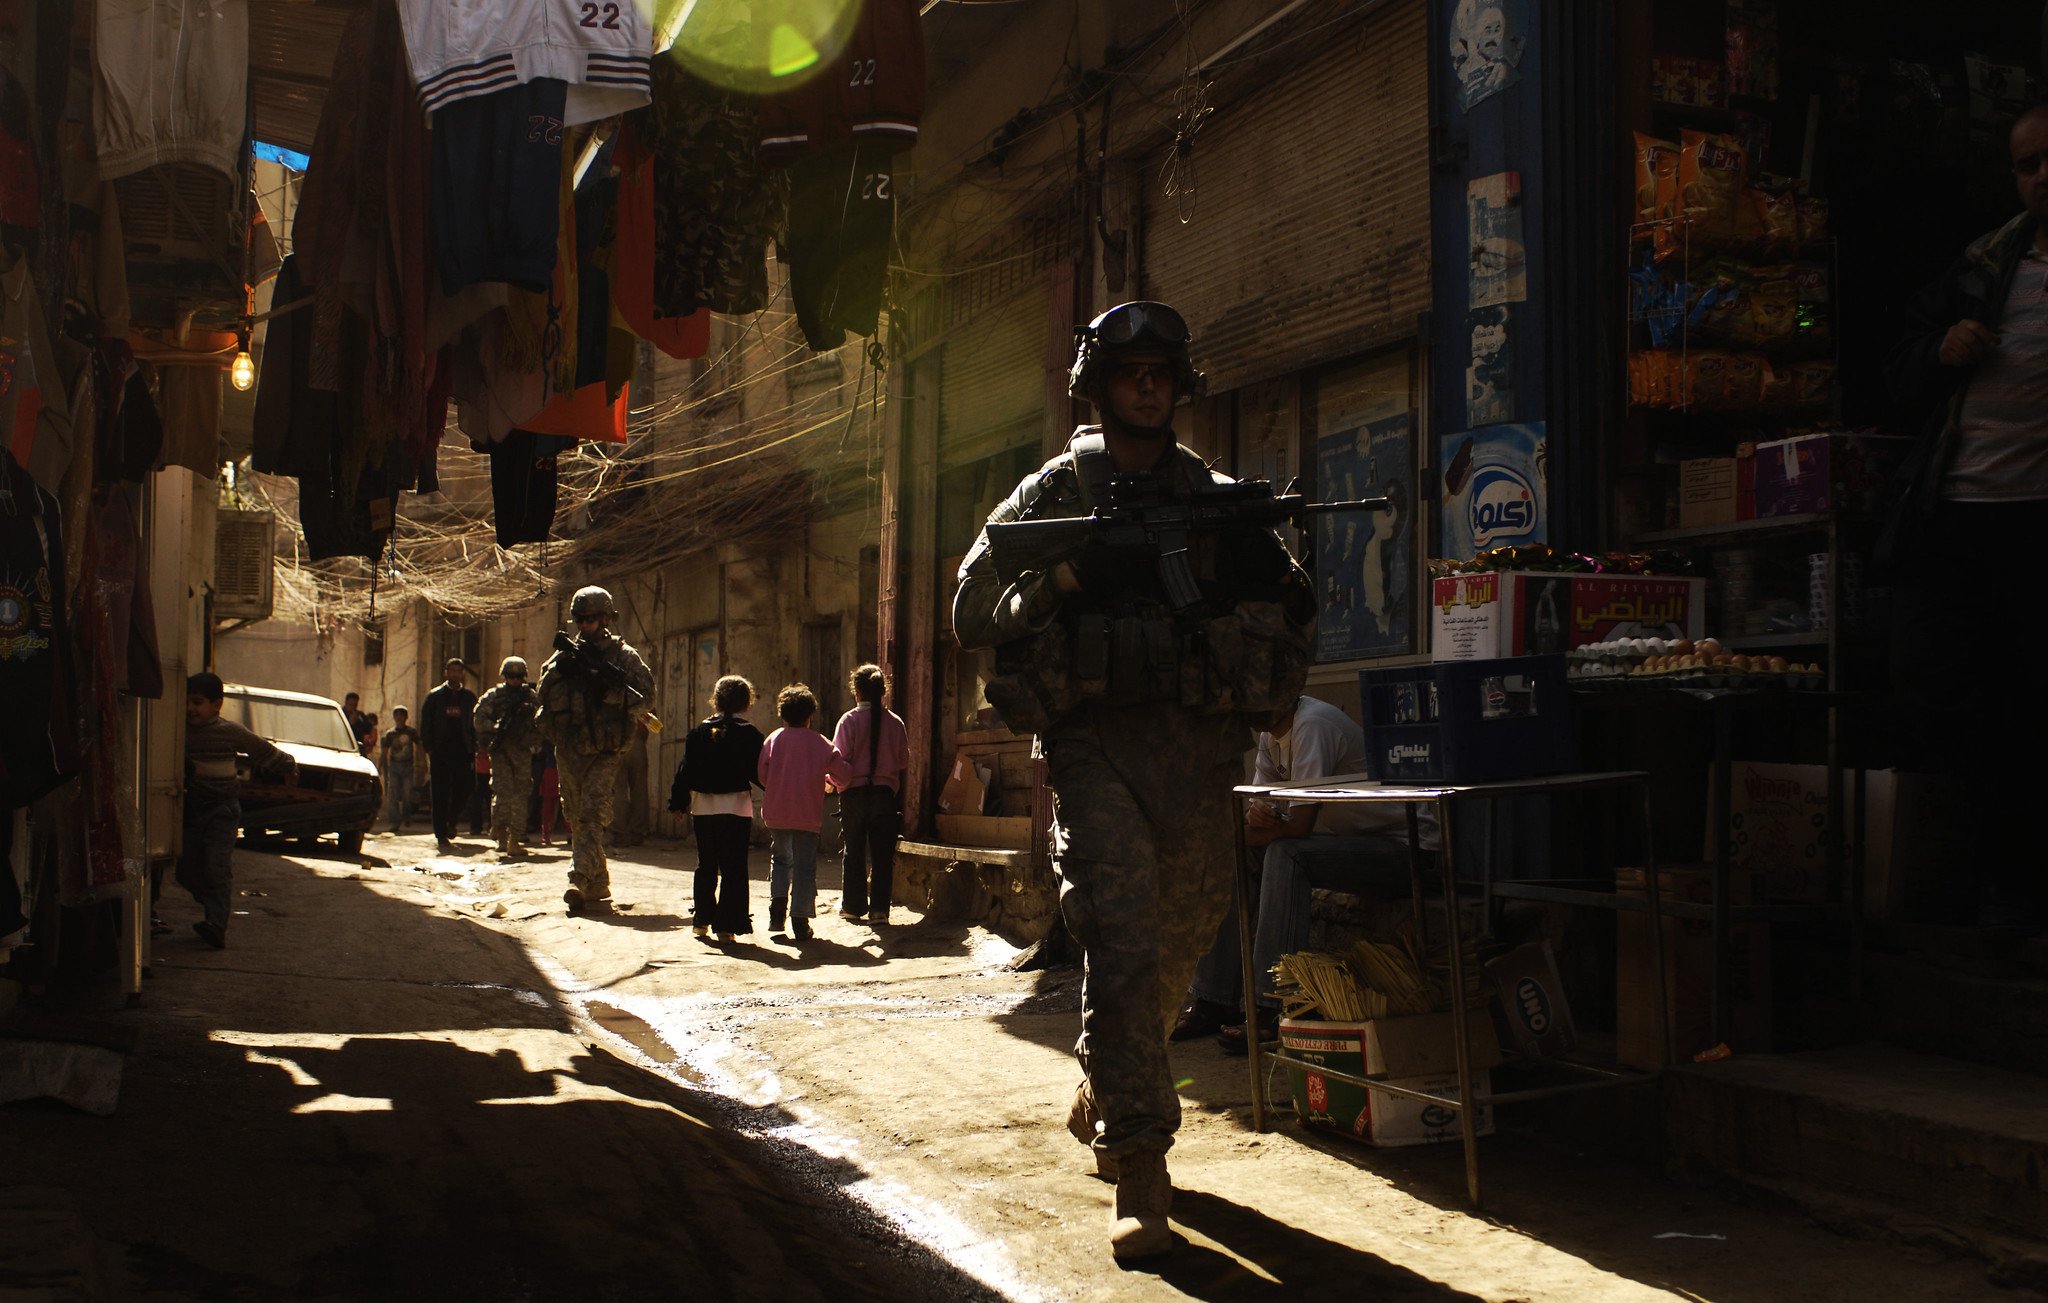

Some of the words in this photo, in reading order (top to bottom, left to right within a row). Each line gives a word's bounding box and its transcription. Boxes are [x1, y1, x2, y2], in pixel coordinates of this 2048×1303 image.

[580, 2, 620, 30] 22
[849, 58, 877, 87] 22
[527, 114, 564, 146] 22
[862, 173, 890, 200] 22
[1441, 581, 1492, 615] الرياي
[1576, 582, 1597, 593] AL
[1609, 582, 1687, 595] RIYADHI
[1575, 591, 1685, 632] الرياضي
[1744, 774, 1801, 801] Winnie
[1518, 982, 1547, 1031] UNO
[1323, 1040, 1348, 1051] PURE
